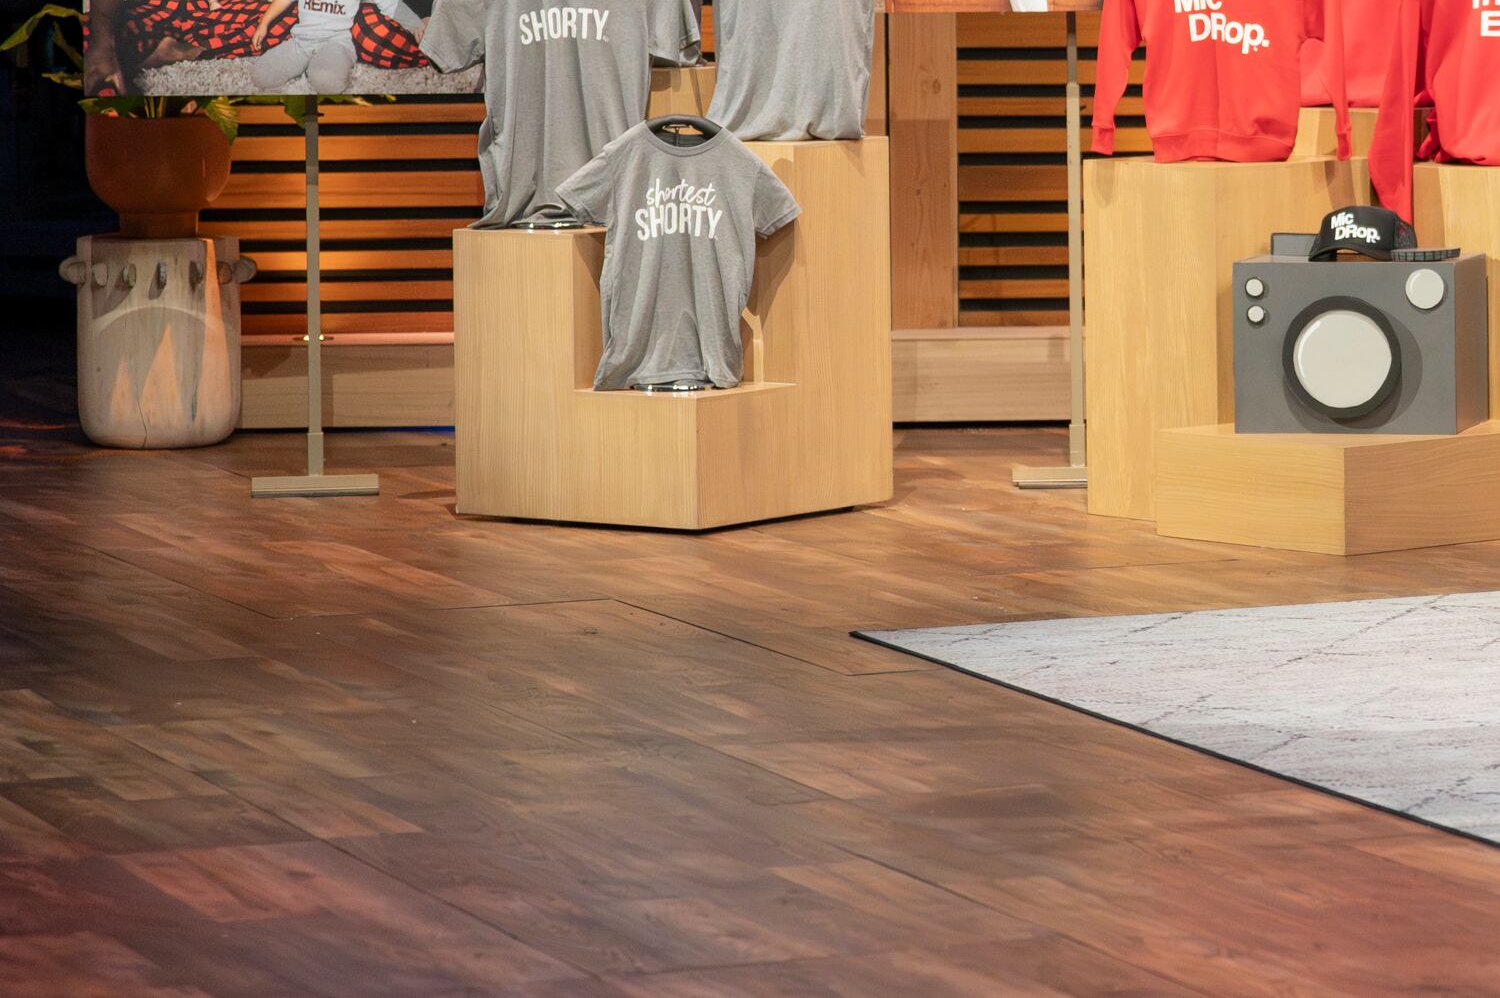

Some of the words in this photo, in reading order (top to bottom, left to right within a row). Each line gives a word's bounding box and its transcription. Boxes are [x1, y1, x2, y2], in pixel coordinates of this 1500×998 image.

[1188, 12, 1270, 55] DRop.
[645, 177, 717, 208] shortest
[1330, 212, 1355, 230] Mic
[1334, 223, 1381, 243] DRop.
